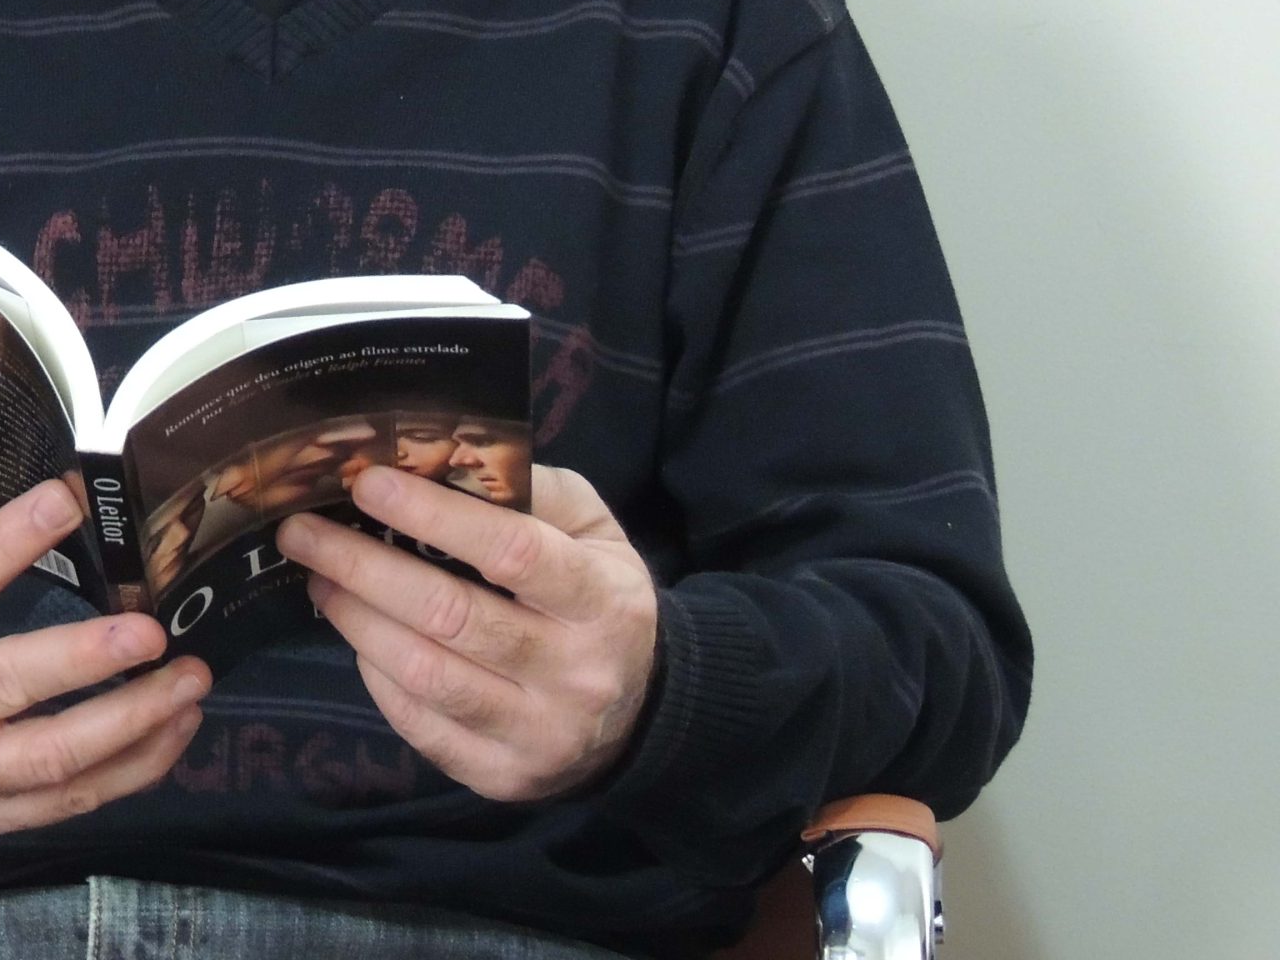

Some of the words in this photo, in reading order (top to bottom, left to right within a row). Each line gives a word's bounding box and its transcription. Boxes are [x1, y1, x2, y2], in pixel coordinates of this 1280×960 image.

[164, 394, 224, 437] Romance
[226, 380, 252, 402] que
[254, 367, 281, 385] deu
[283, 355, 334, 375] origem
[338, 350, 358, 360] ao
[360, 346, 399, 357] filme
[403, 343, 470, 355] estrelado
[93, 477, 120, 491] O
[98, 497, 126, 545] Leitor
[170, 585, 214, 637] O
